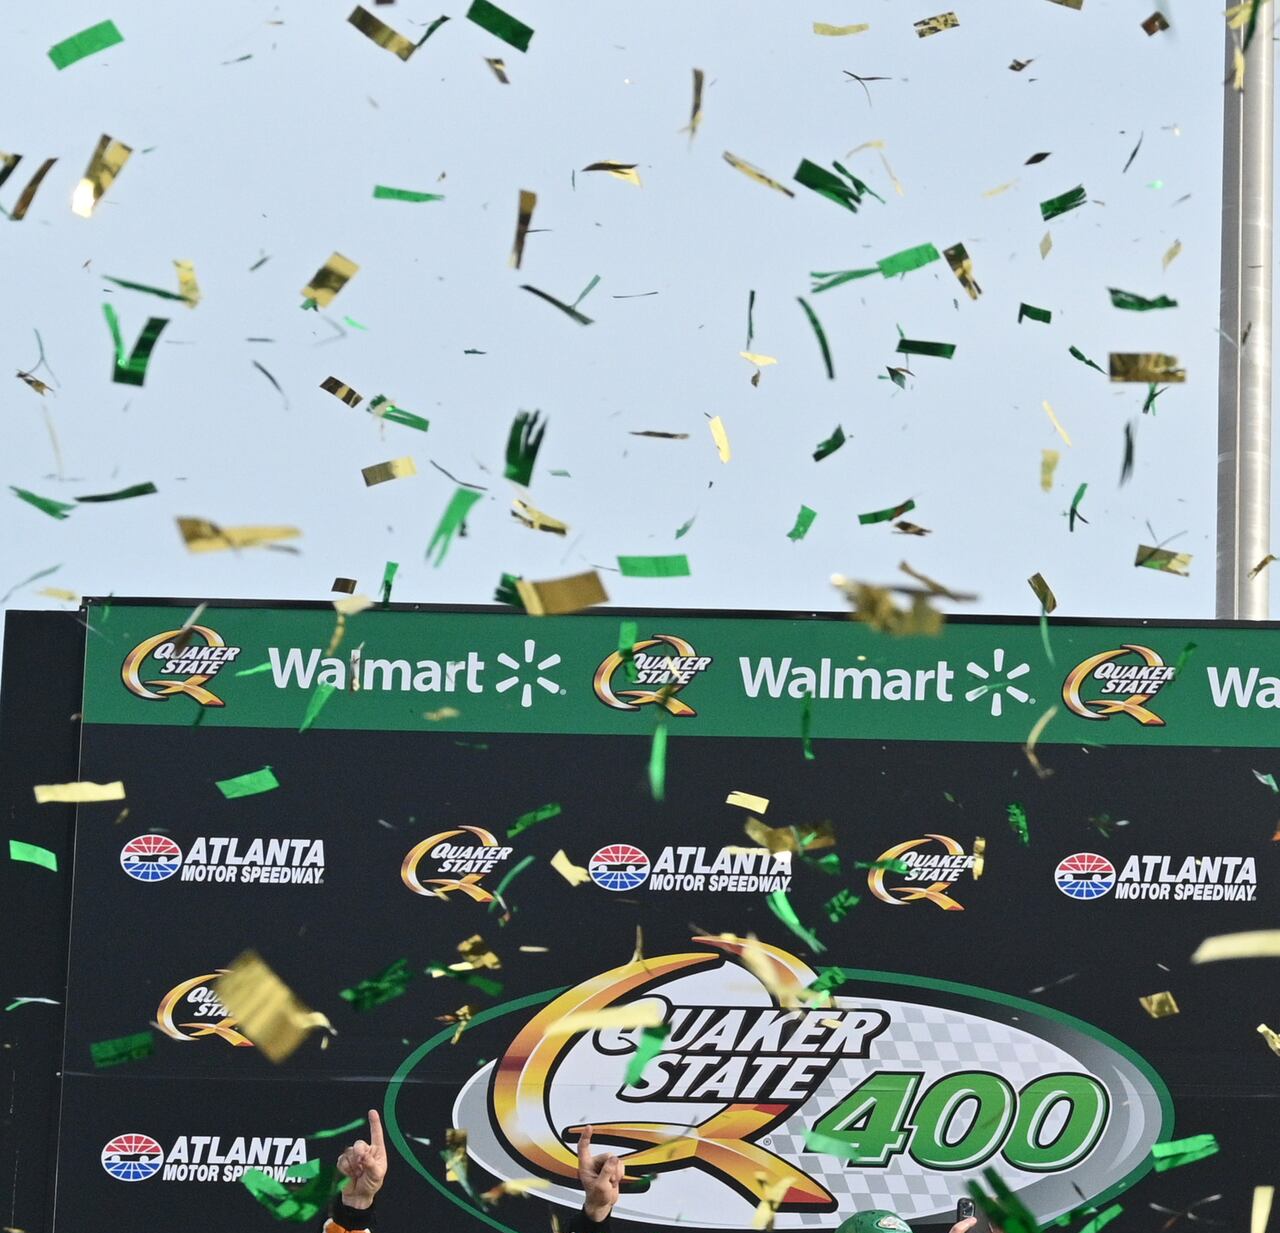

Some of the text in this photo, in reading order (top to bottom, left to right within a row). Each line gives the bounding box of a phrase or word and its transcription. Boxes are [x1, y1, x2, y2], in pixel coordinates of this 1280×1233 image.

[160, 657, 232, 676] STATE
[268, 647, 485, 693] Walmart
[1094, 661, 1177, 683] QUAKER
[739, 656, 953, 701] Walmart
[1103, 677, 1162, 696] STATE
[184, 838, 325, 866] ATLANTA
[430, 842, 513, 863] QUAKER
[649, 846, 793, 875] ATLANTA
[181, 864, 324, 884] MOTOR SPEEDWAY
[437, 857, 495, 874] STATE
[905, 867, 964, 882] STATE
[1118, 857, 1257, 886] ATLANTA
[648, 874, 791, 893] MOTOR SPEEDWAY
[1115, 884, 1256, 902] MOTOR SPEEDWAY
[616, 1053, 830, 1102] STATE
[802, 1068, 1112, 1177] 400
[166, 1135, 308, 1166] ATLANTA
[162, 1163, 219, 1182] MOTOR
